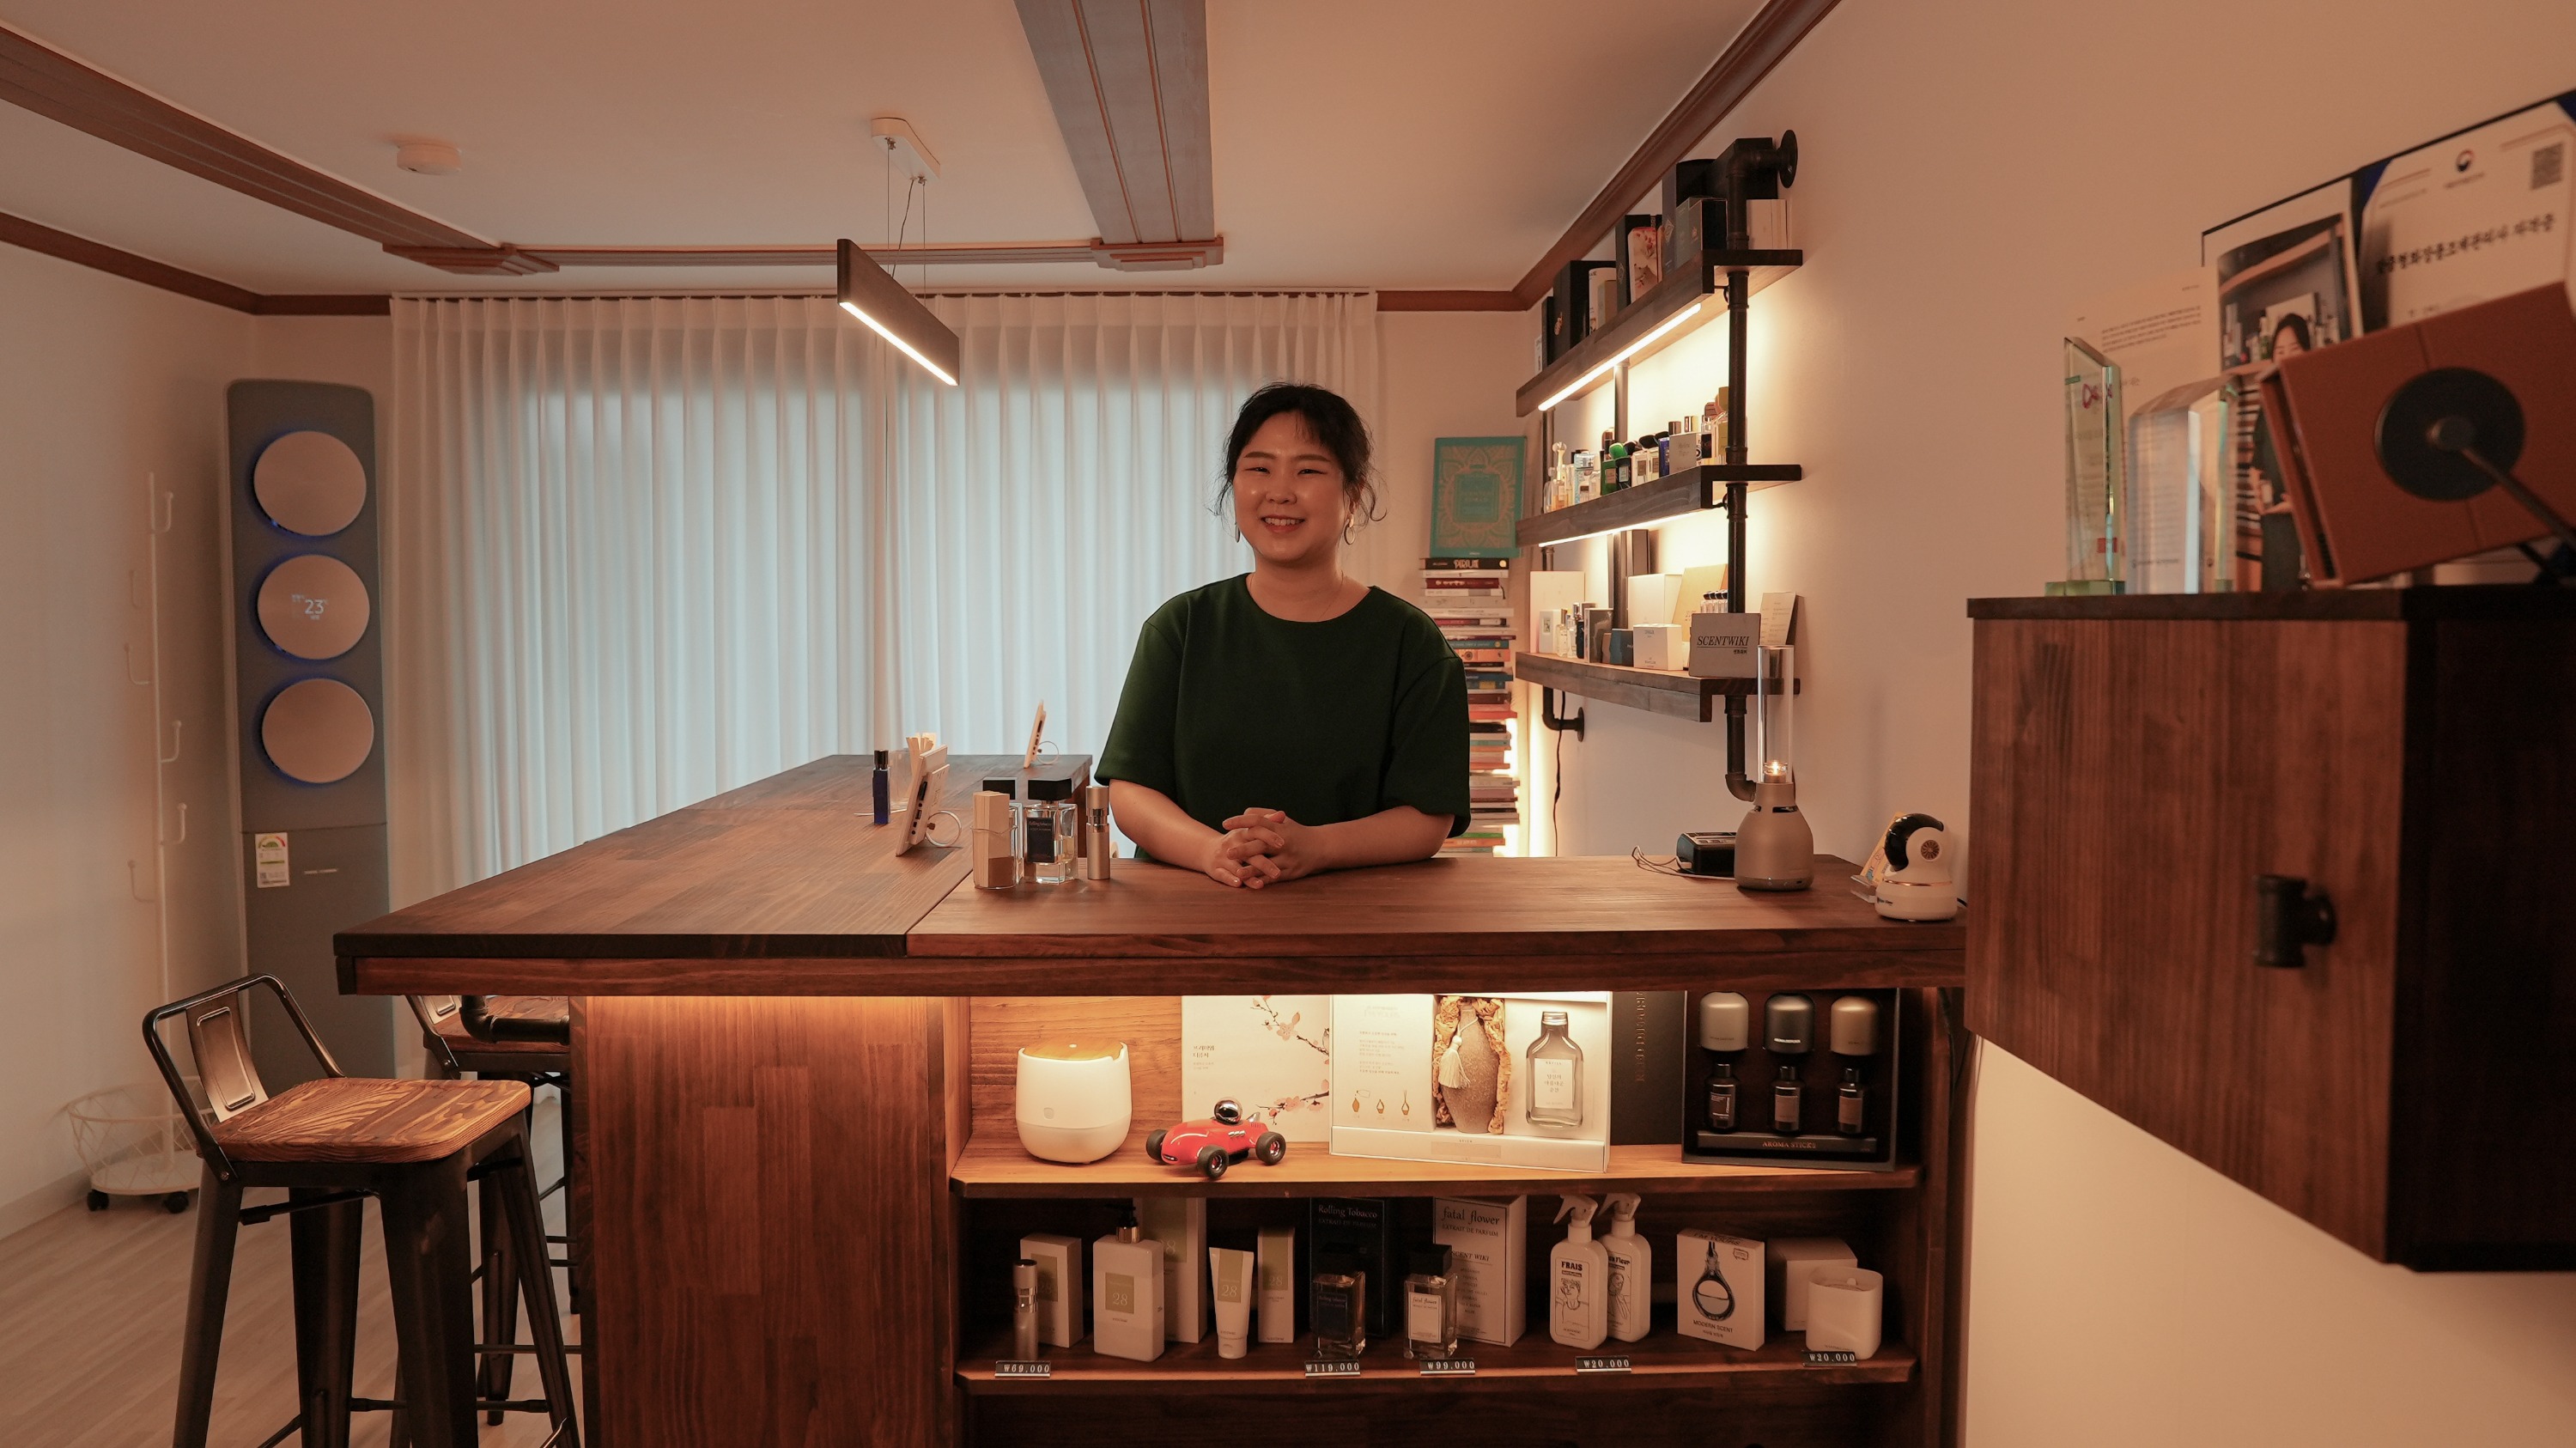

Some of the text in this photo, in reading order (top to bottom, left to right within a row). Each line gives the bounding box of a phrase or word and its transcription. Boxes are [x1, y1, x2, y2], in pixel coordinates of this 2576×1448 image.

[305, 599, 324, 614] 23
[1697, 636, 1749, 646] SCENTWIKI
[1318, 1205, 1377, 1219] Rolling Tobacco
[1442, 1206, 1501, 1226] fatal flower
[1443, 1224, 1464, 1232] EXTRAIT
[1475, 1228, 1499, 1238] PARFUM
[1473, 1253, 1490, 1262] WIKI
[1561, 1261, 1583, 1271] FRAIS
[1269, 1275, 1284, 1287] 28
[1222, 1284, 1238, 1297] 28
[1112, 1292, 1128, 1306] 28
[1692, 1320, 1733, 1333] MODERN SCENT
